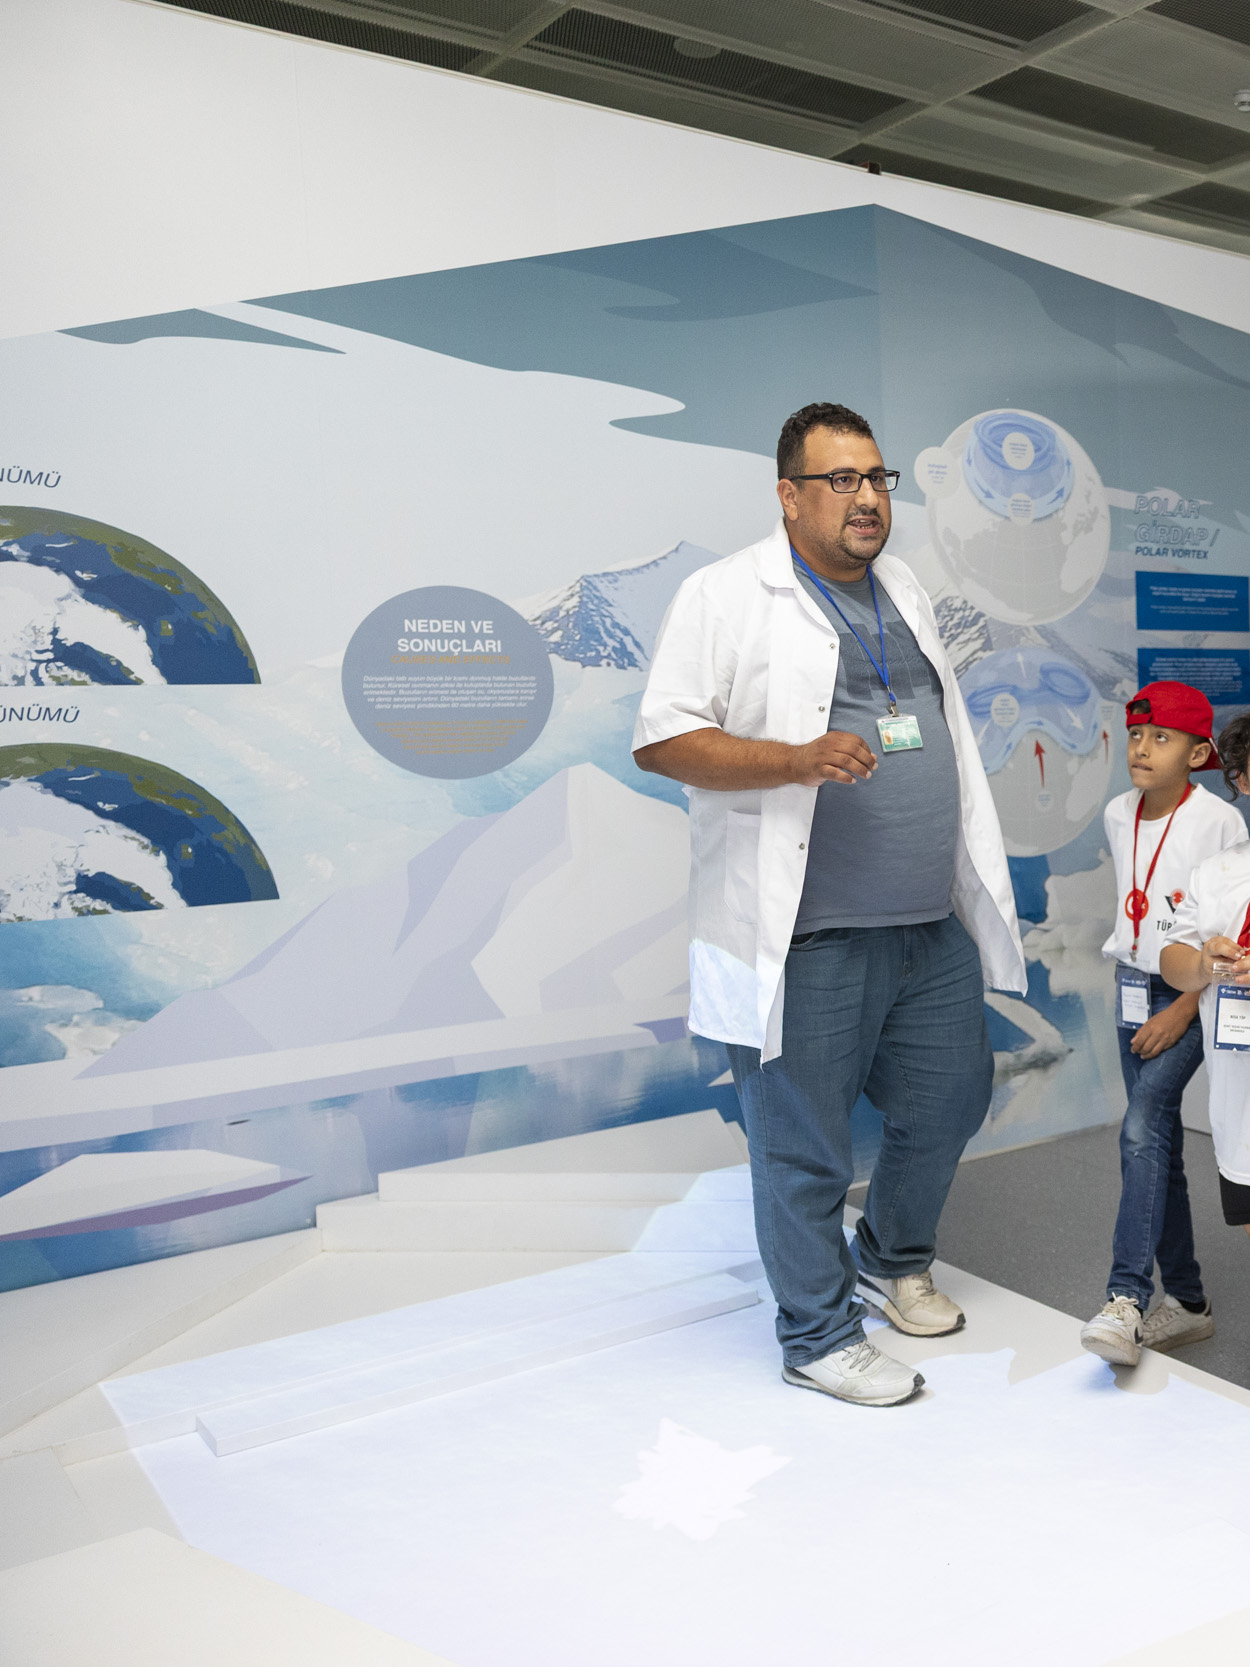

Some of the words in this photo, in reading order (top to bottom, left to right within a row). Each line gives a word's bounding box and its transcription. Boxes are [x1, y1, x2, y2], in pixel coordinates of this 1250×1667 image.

[0, 465, 61, 488] ÜMÜ
[1134, 495, 1200, 519] POLAR
[1135, 546, 1169, 557] POLAR
[1171, 547, 1209, 560] VORTEX
[404, 619, 466, 633] NEDEN
[471, 620, 494, 634] VE
[397, 639, 502, 656] SONUÇLARI
[391, 655, 436, 664] CAUSES
[438, 655, 461, 664] AND
[463, 655, 510, 665] EFFECTS
